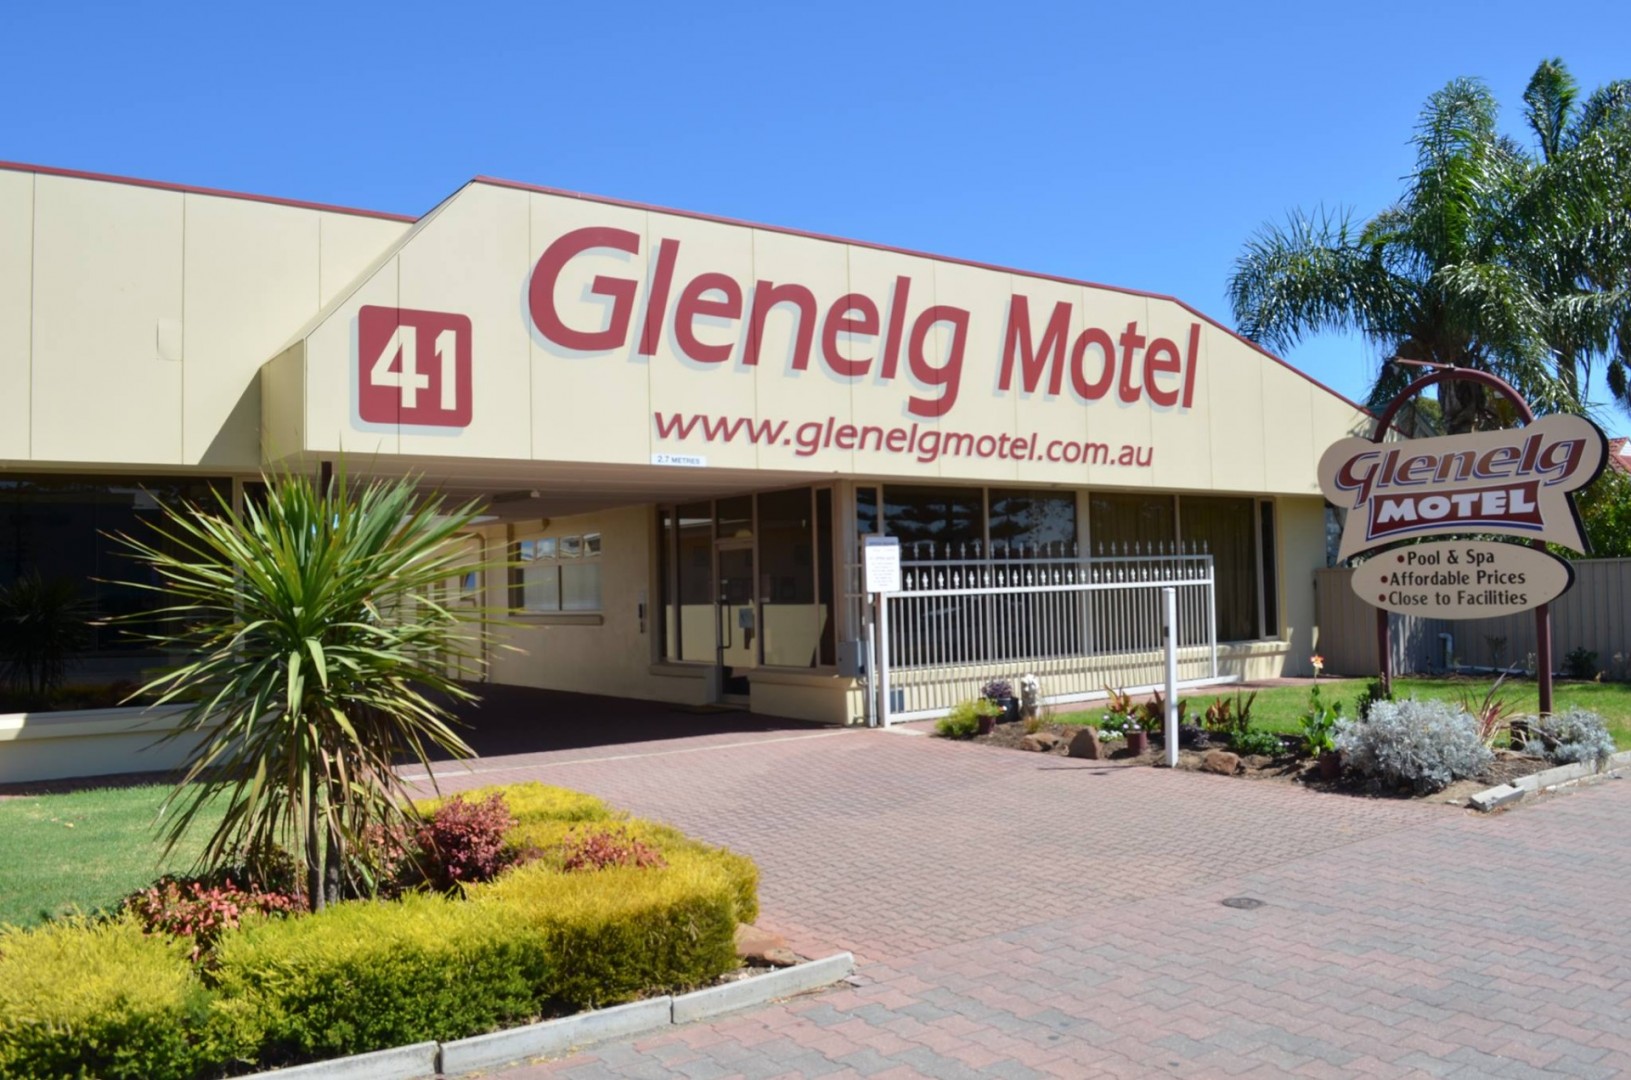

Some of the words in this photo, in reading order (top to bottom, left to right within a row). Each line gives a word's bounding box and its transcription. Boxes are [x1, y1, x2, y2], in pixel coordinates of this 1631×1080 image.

[528, 226, 971, 417] Glenelg
[998, 293, 1201, 409] Motel
[370, 324, 457, 411] 41
[654, 411, 1154, 467] www.glenelgmotel.com.au
[671, 457, 700, 465] METRES
[1334, 433, 1587, 510] Glenelg
[1376, 488, 1537, 524] MOTEL
[1407, 550, 1440, 566] Pool
[1447, 549, 1459, 565] &
[1466, 549, 1495, 567] Spa
[1389, 570, 1470, 587] Affordable
[1476, 569, 1526, 585] Prices
[1388, 590, 1428, 606] Close
[1435, 591, 1451, 606] to
[1457, 589, 1528, 606] Facilities
